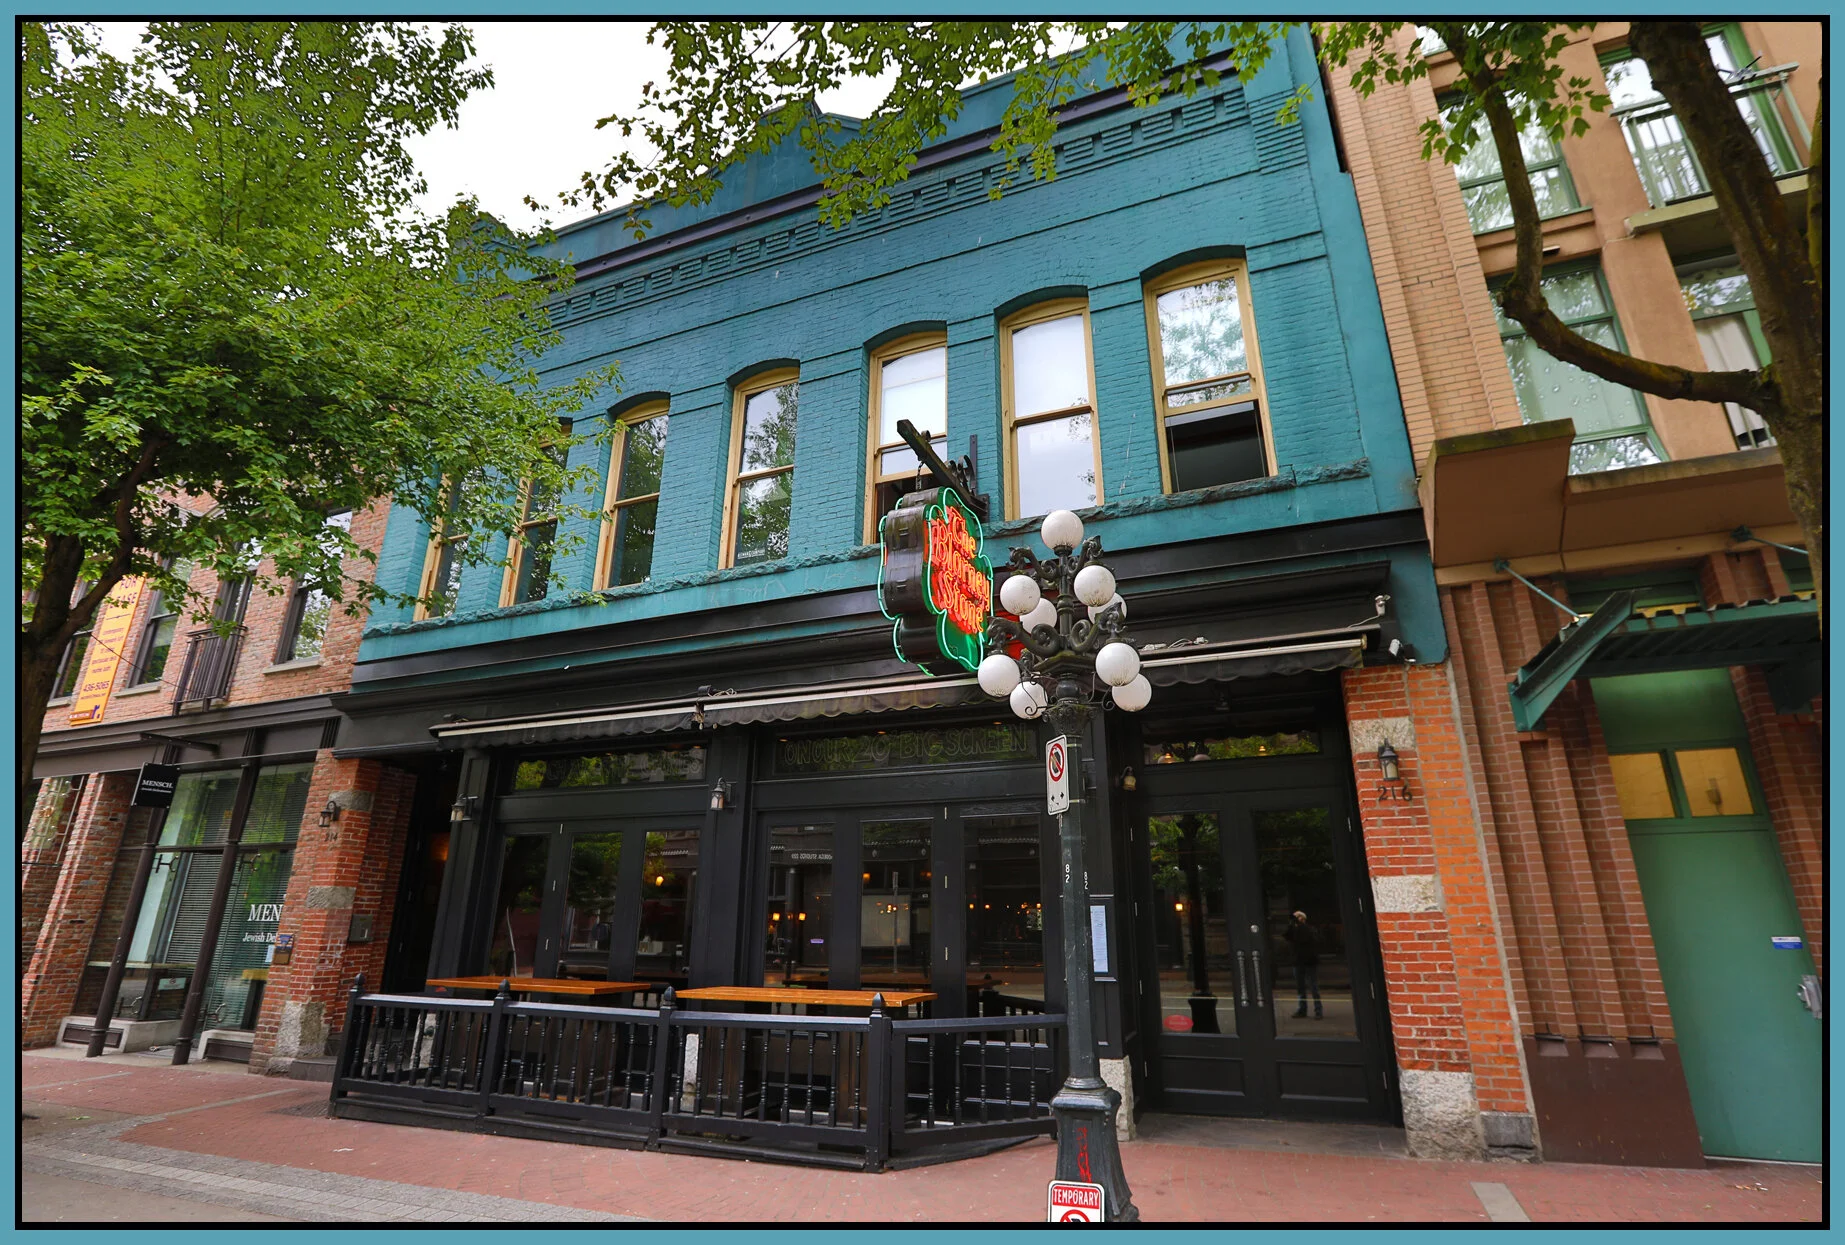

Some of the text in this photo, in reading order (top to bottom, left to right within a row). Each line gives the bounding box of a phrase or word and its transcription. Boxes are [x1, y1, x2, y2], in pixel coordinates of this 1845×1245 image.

[949, 506, 976, 558] The
[935, 518, 990, 611] Blarney
[943, 571, 984, 633] Stone
[944, 723, 1027, 756] SCREEN
[1378, 786, 1413, 801] 216
[242, 932, 265, 942] Jewish
[1053, 1189, 1100, 1207] TEMPORARY
